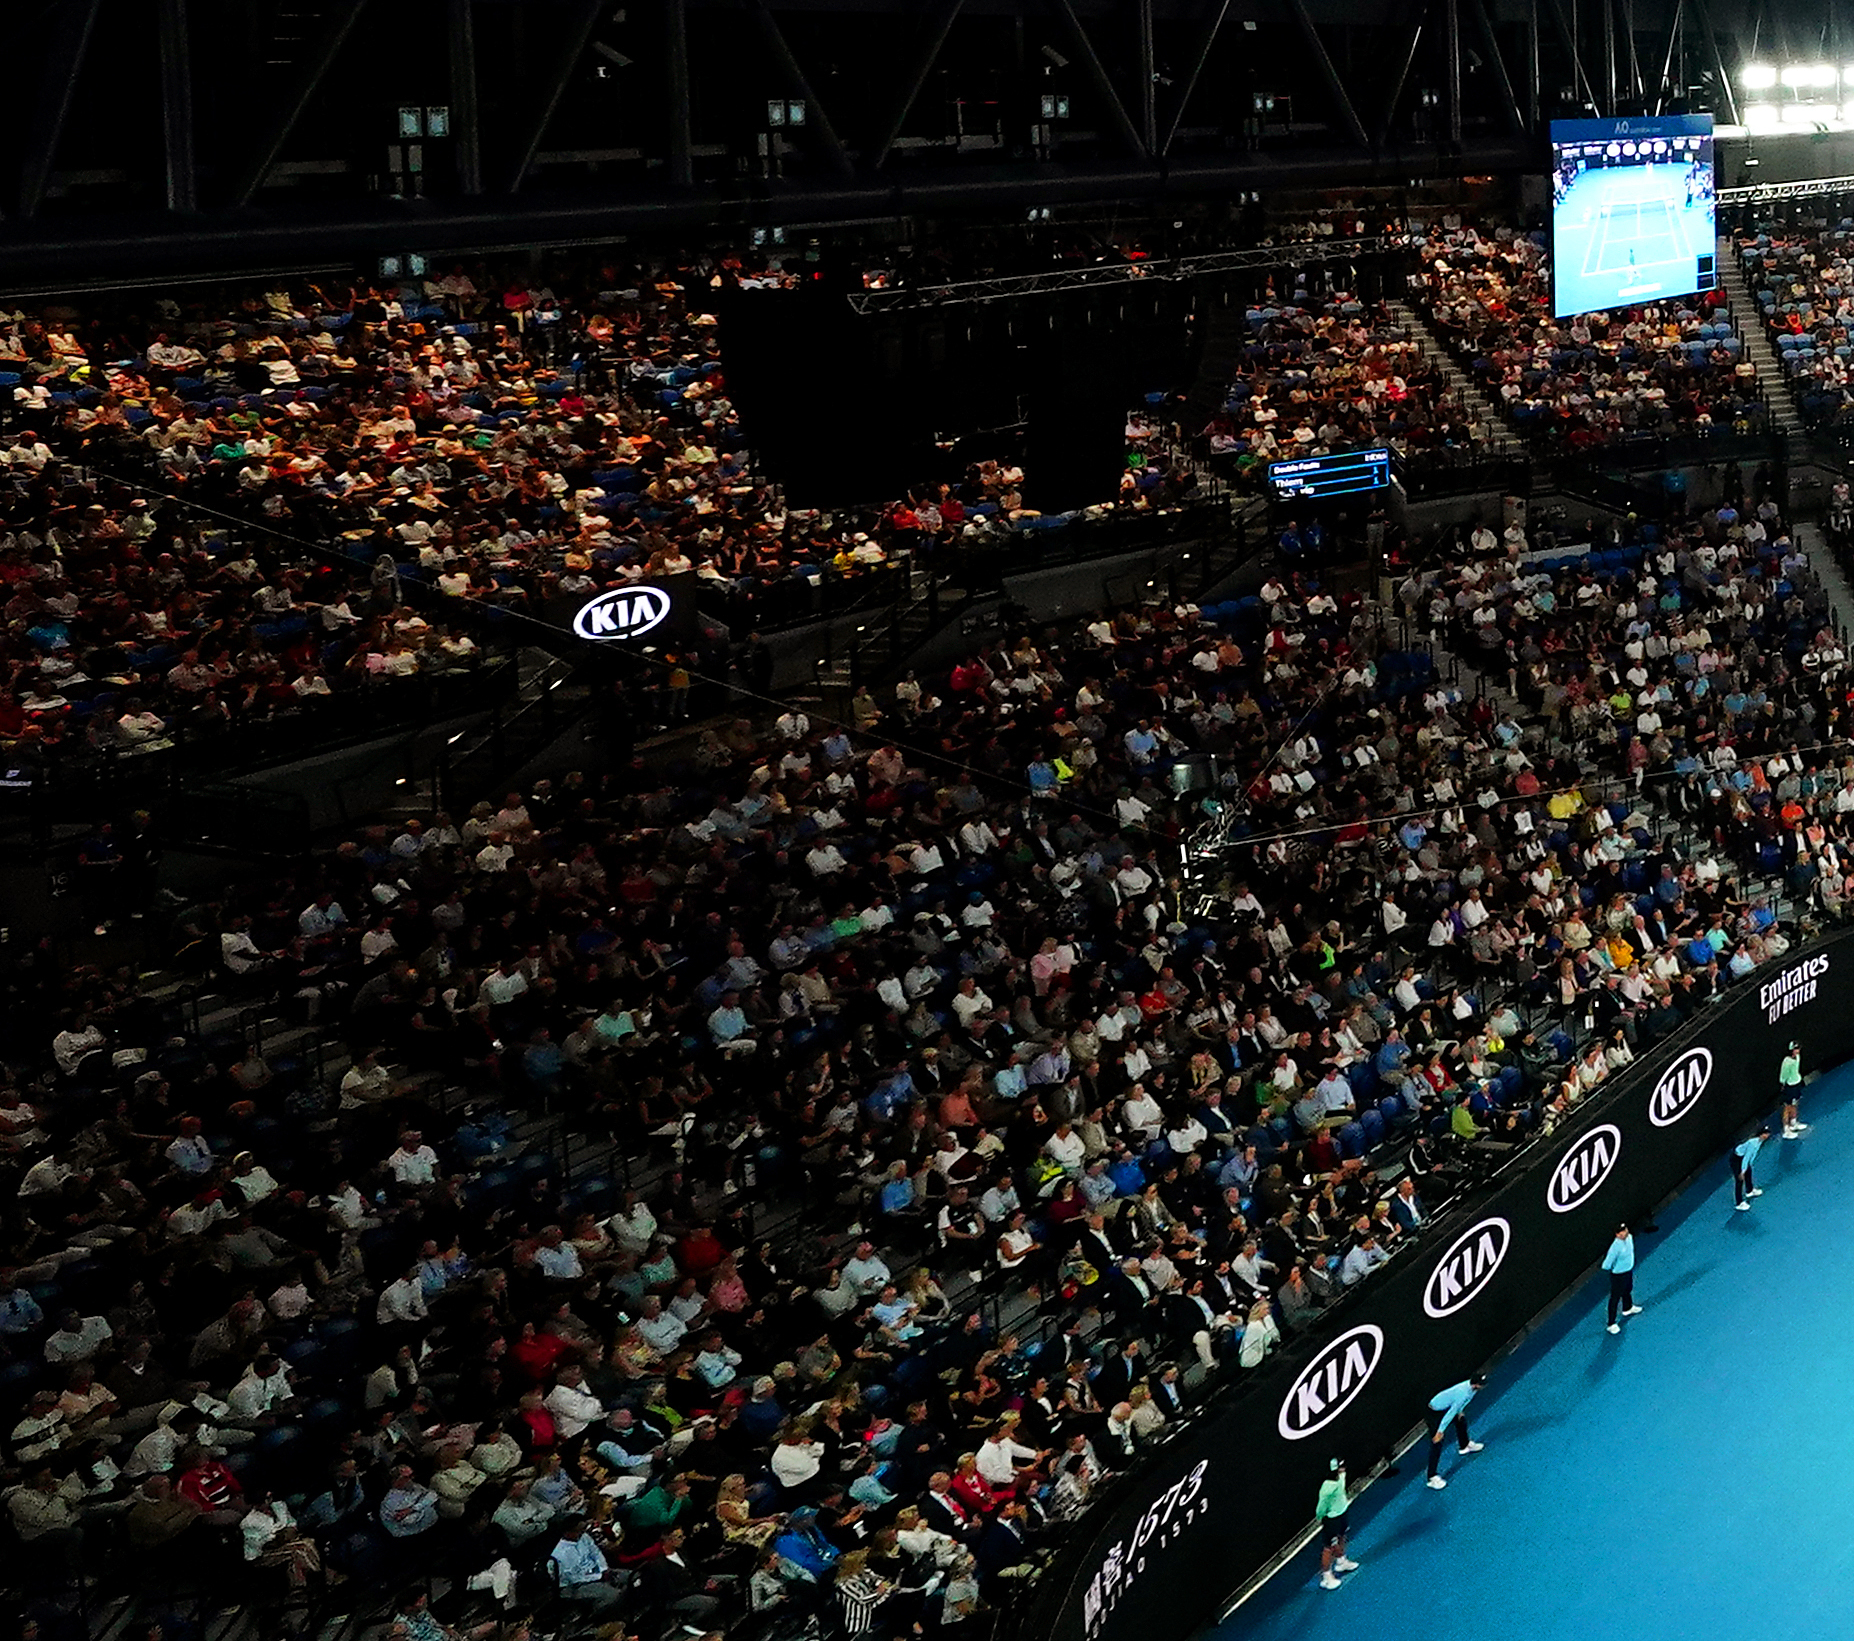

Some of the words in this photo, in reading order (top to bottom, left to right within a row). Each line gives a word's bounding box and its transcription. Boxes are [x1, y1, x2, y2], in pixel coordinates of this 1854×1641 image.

[591, 593, 654, 633] KIA
[1760, 953, 1829, 1010] Emirates
[1769, 995, 1783, 1025] FLY
[1783, 980, 1817, 1015] BETTER
[1661, 1059, 1702, 1117] KIA
[1561, 1138, 1608, 1202] KIA
[1440, 1232, 1496, 1307] KIA
[1298, 1341, 1366, 1427] KIA
